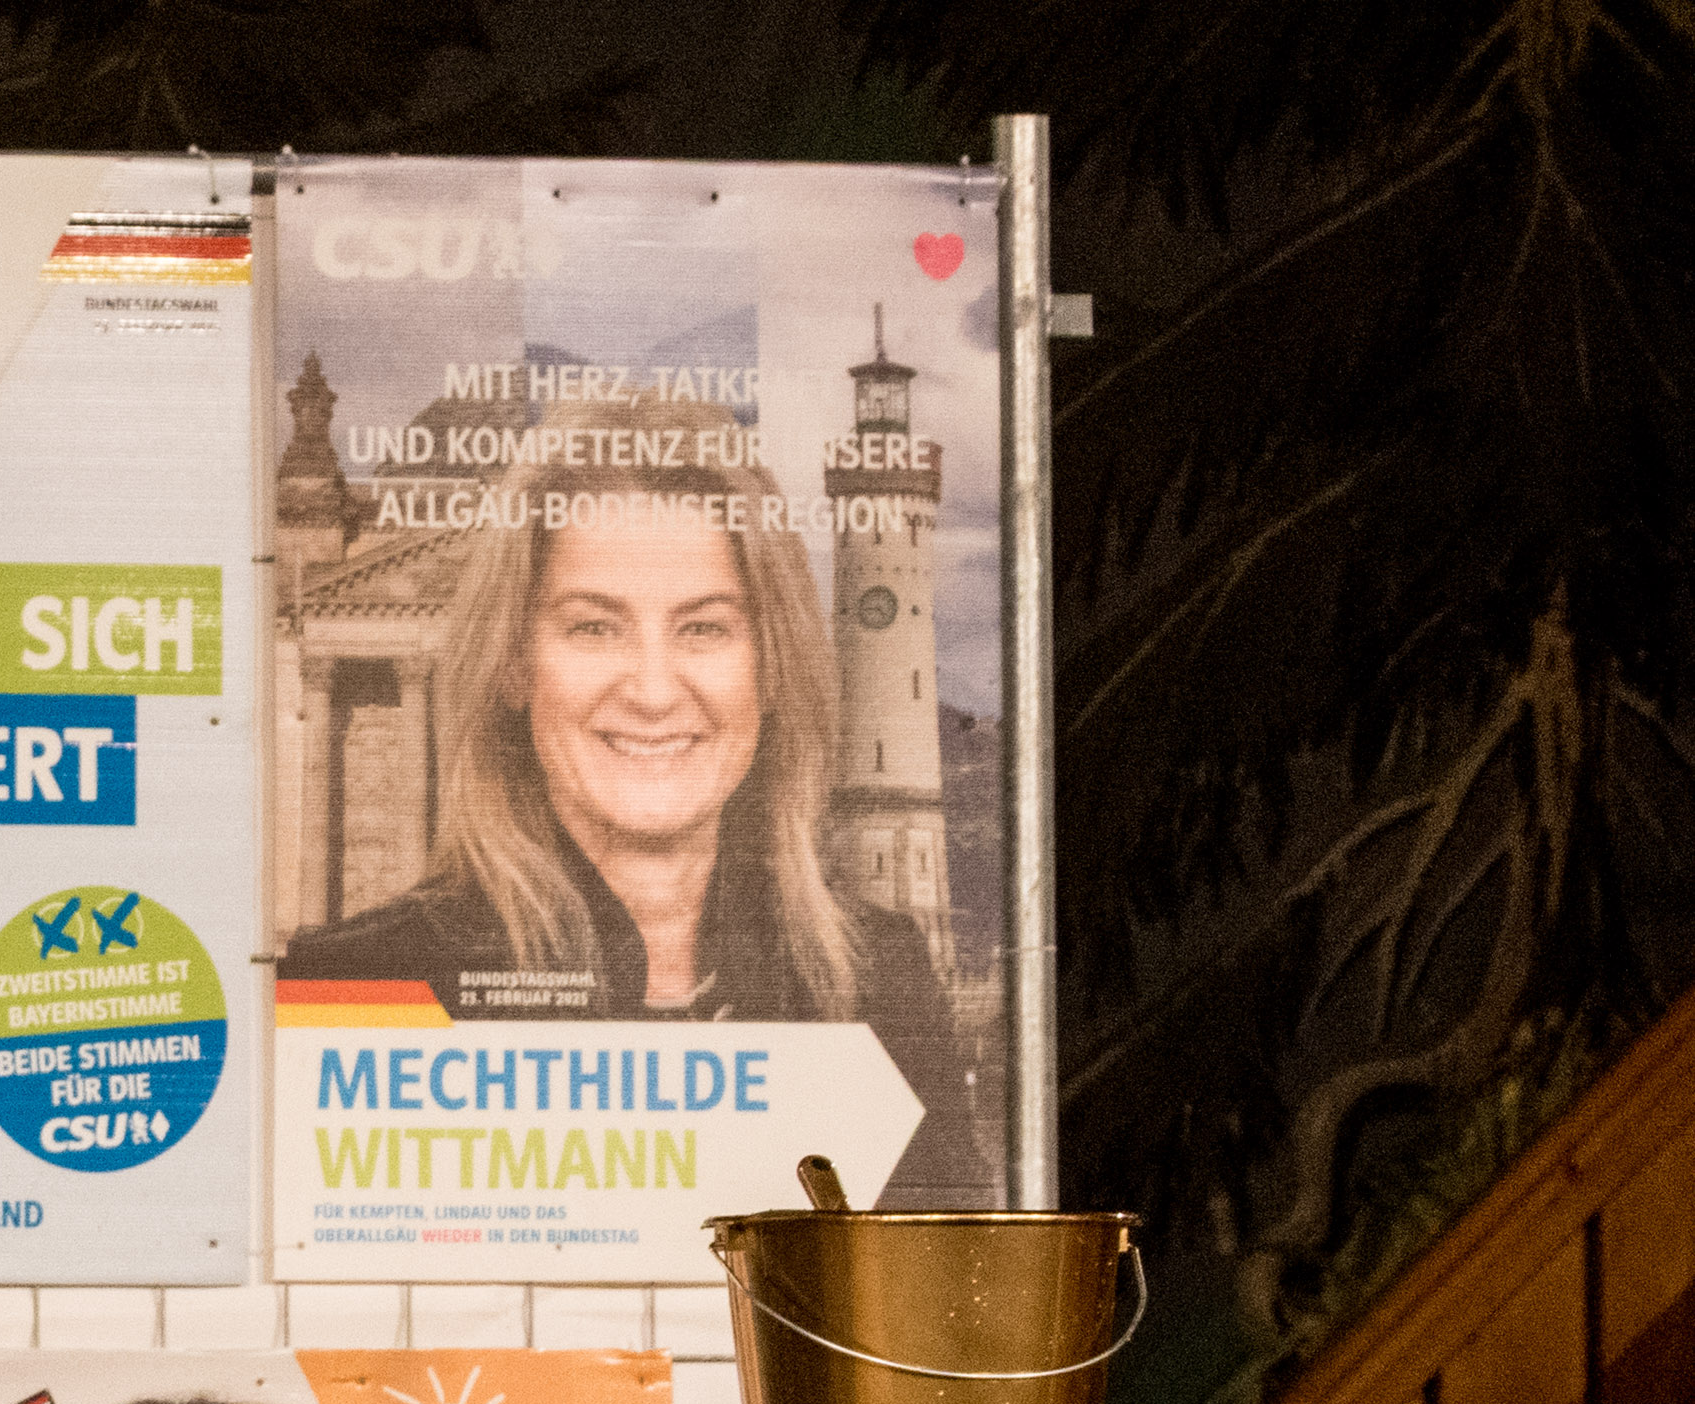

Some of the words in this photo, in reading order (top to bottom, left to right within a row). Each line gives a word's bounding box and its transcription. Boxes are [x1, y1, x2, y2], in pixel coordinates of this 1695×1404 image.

[315, 218, 479, 280] CSU
[445, 363, 513, 401] MIT
[528, 363, 641, 408] HERZ,
[349, 427, 434, 465] UND
[446, 428, 685, 468] KOMPETENZ
[696, 425, 769, 468] FÜR
[804, 430, 932, 471] NSERE
[761, 494, 907, 534] REGION
[21, 594, 195, 674] SICH
[156, 959, 191, 984] IST
[459, 970, 596, 988] BUNDESTAGSWAHL
[8, 991, 184, 1030] BAYERNSTIMME
[78, 1034, 201, 1070] STIMMEN
[50, 1073, 103, 1107] FÜR
[107, 1071, 152, 1102] DIE
[316, 1047, 770, 1113] MECHTHILDE
[40, 1112, 129, 1154] CSU
[314, 1126, 699, 1191] WITTMANN
[434, 1205, 493, 1220] LINDAU
[496, 1205, 532, 1220] UND
[535, 1205, 568, 1220] DAS
[421, 1228, 483, 1244] WIEDER
[487, 1228, 505, 1243] IN
[510, 1228, 541, 1244] DEN
[546, 1228, 640, 1245] BUNDESTAG
